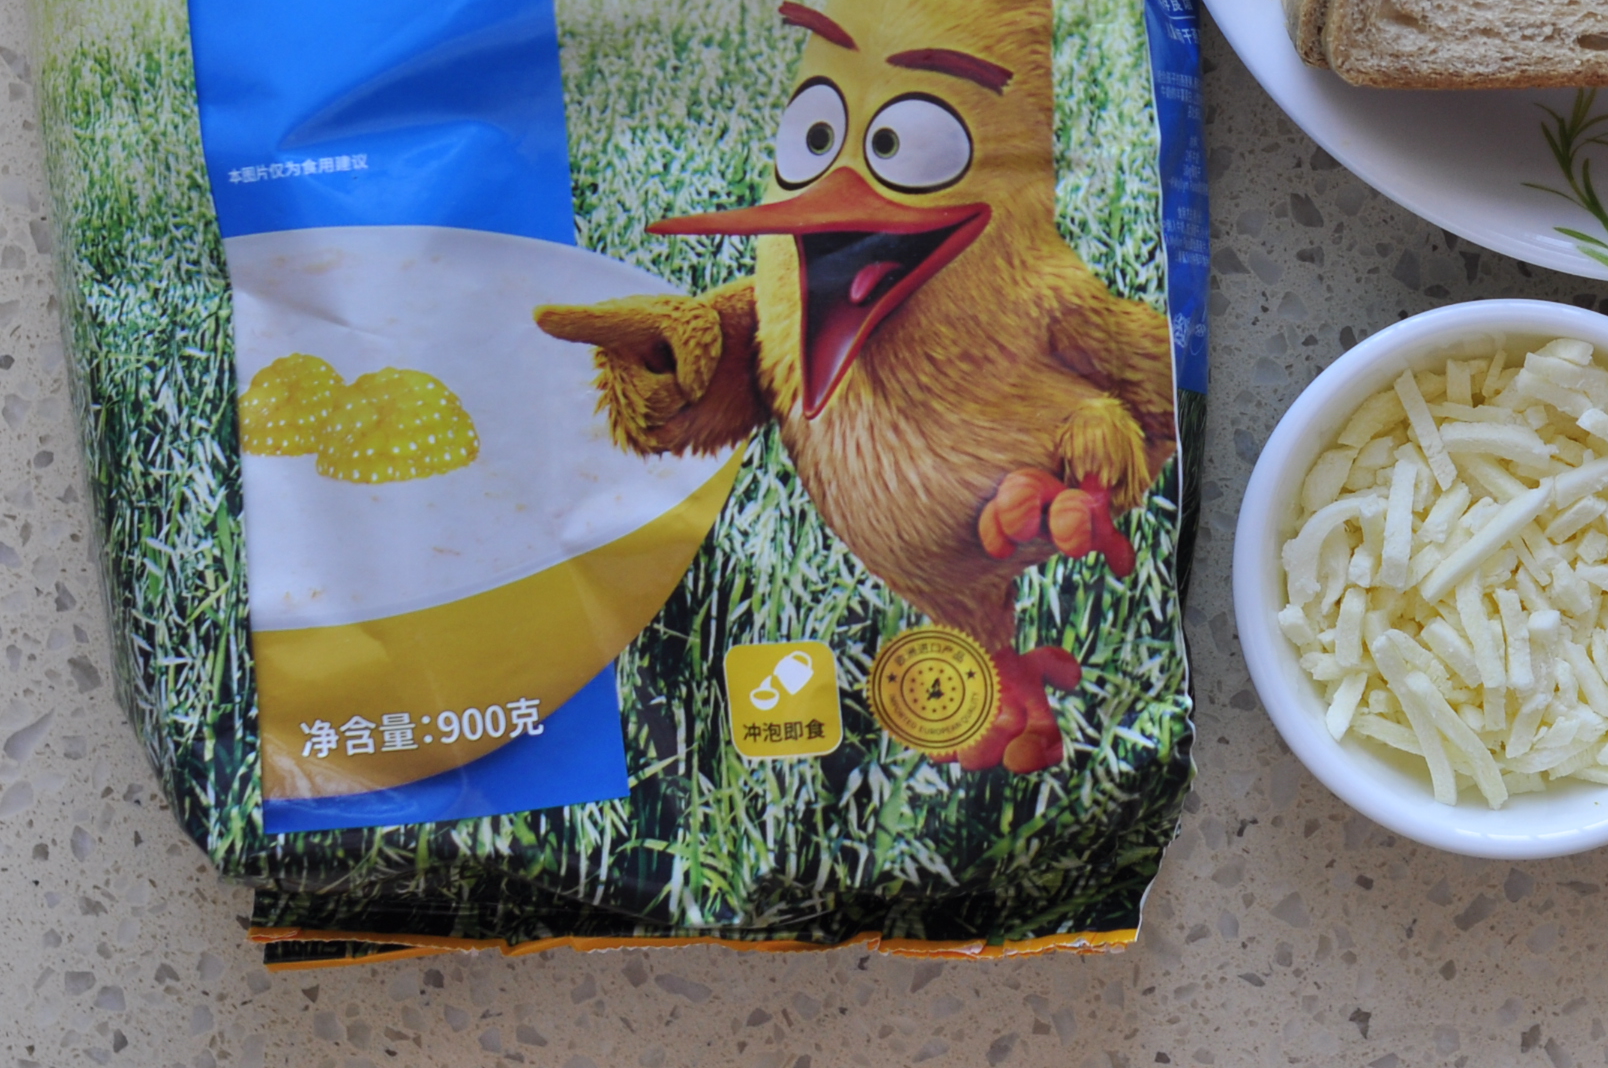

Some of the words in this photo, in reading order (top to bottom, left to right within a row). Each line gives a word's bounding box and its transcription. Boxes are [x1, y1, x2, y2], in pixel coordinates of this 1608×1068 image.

[228, 153, 369, 184] 本图片仅为食用建议
[743, 718, 826, 743] 冲泡即食
